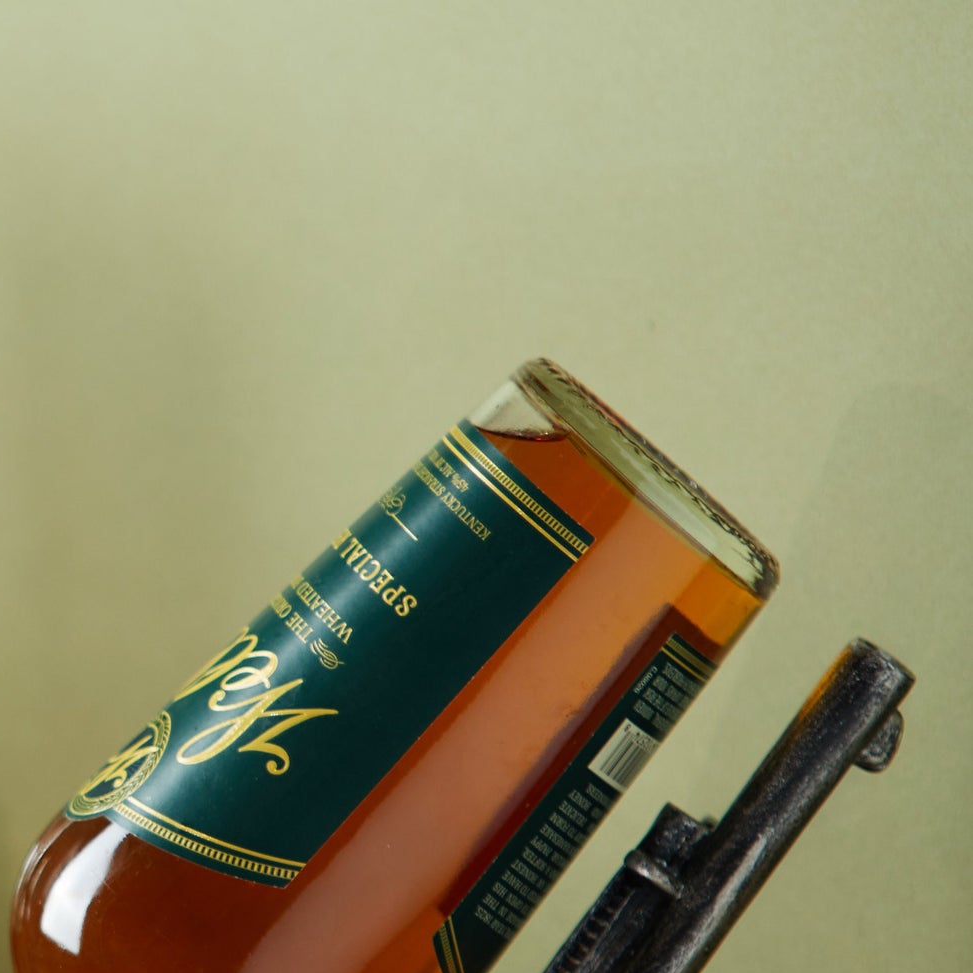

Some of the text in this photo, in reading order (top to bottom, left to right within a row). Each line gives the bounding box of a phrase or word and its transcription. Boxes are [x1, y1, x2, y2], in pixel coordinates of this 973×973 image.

[440, 490, 491, 541] KENTUCKY
[338, 536, 420, 619] SPECIAL
[285, 611, 316, 642] THE
[295, 580, 356, 644] WHEATED
[500, 870, 524, 890] HAVE
